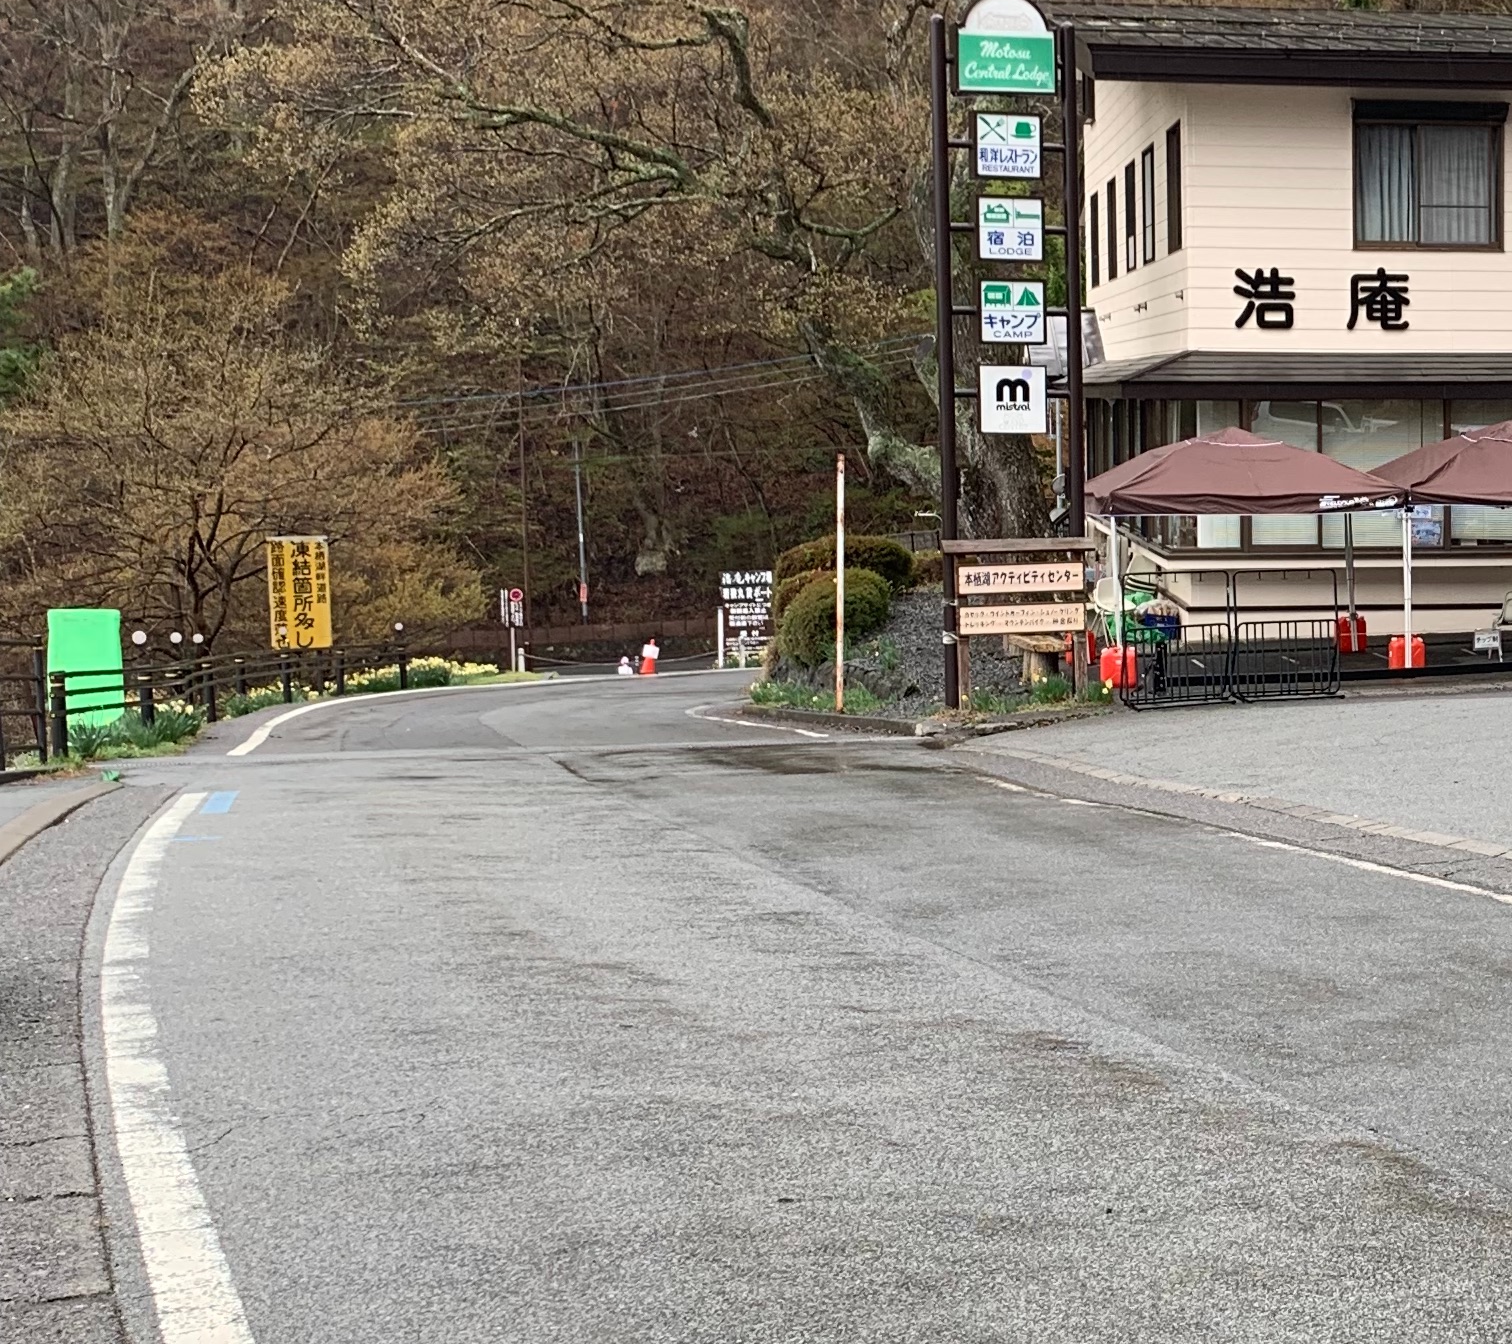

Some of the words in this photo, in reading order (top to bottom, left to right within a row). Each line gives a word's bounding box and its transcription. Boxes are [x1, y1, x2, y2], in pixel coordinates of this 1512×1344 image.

[979, 40, 1031, 60] Motosu
[964, 61, 1011, 81] Central
[1013, 63, 1049, 86] Lodge
[979, 147, 1038, 164] 和洋レストラン
[982, 164, 1035, 174] RESTAURANT
[987, 230, 1035, 246] 宿泊
[989, 247, 1033, 256] LODGE
[1233, 267, 1411, 331] 浩庵
[983, 312, 1041, 329] キャンプ
[993, 330, 1033, 339] CAMP
[996, 402, 1031, 412] mistral
[964, 570, 1079, 587] 本栖湖アクティビティセンター
[290, 540, 315, 648] 凍結箇所多し
